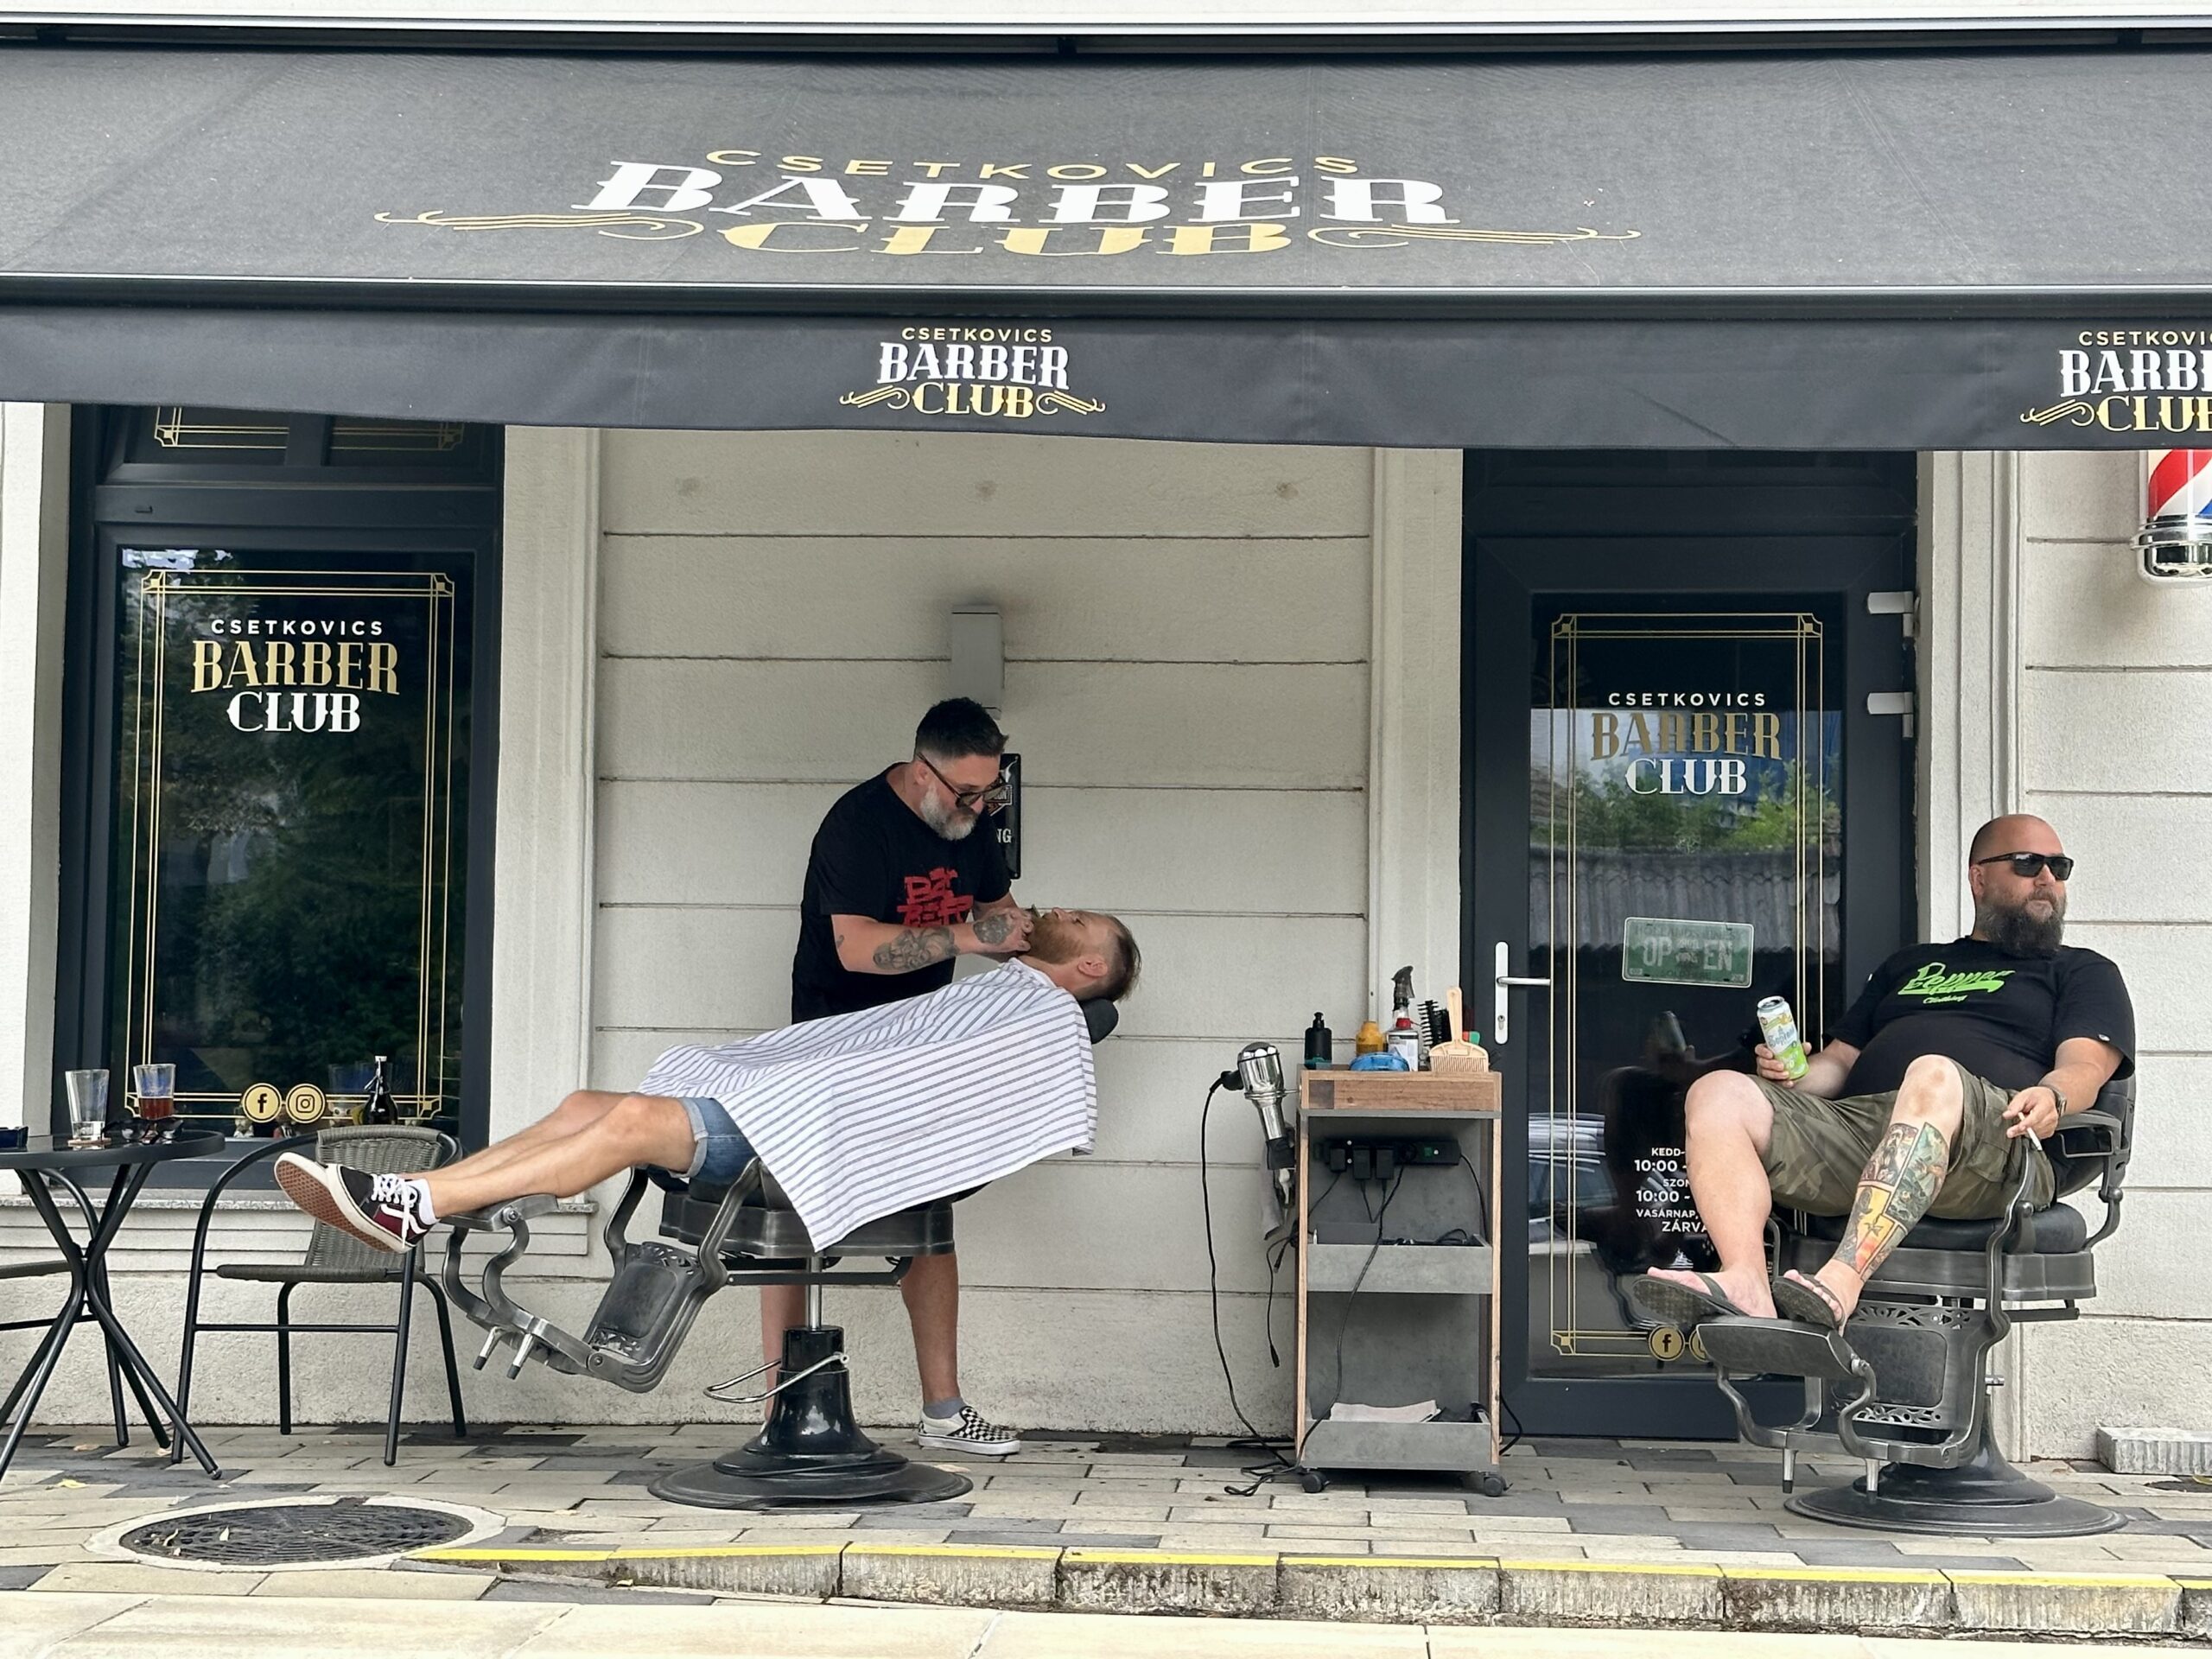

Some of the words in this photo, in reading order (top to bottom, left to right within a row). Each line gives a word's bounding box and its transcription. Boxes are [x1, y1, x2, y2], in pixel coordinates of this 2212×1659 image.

[706, 149, 1359, 180] CSETKOVICS
[571, 160, 1460, 225] BARBER
[717, 222, 1293, 256] CLUB
[901, 327, 1052, 343] CSETKOVICS
[2078, 331, 2212, 346] CSETKOVI
[877, 342, 1070, 391] BARBER
[912, 382, 1034, 419] CLUB
[211, 619, 383, 635] CSETKOVICS
[191, 639, 399, 695] BARBER
[226, 691, 360, 733] CLUB
[1608, 692, 1765, 707] CSETKOVICS
[1591, 712, 1782, 760] BARBER
[1624, 758, 1747, 795] CLUB
[1634, 1160, 1678, 1172] 10:00
[1636, 1190, 1680, 1202] 10:00
[1636, 1207, 1699, 1219] VASÁRNAP,
